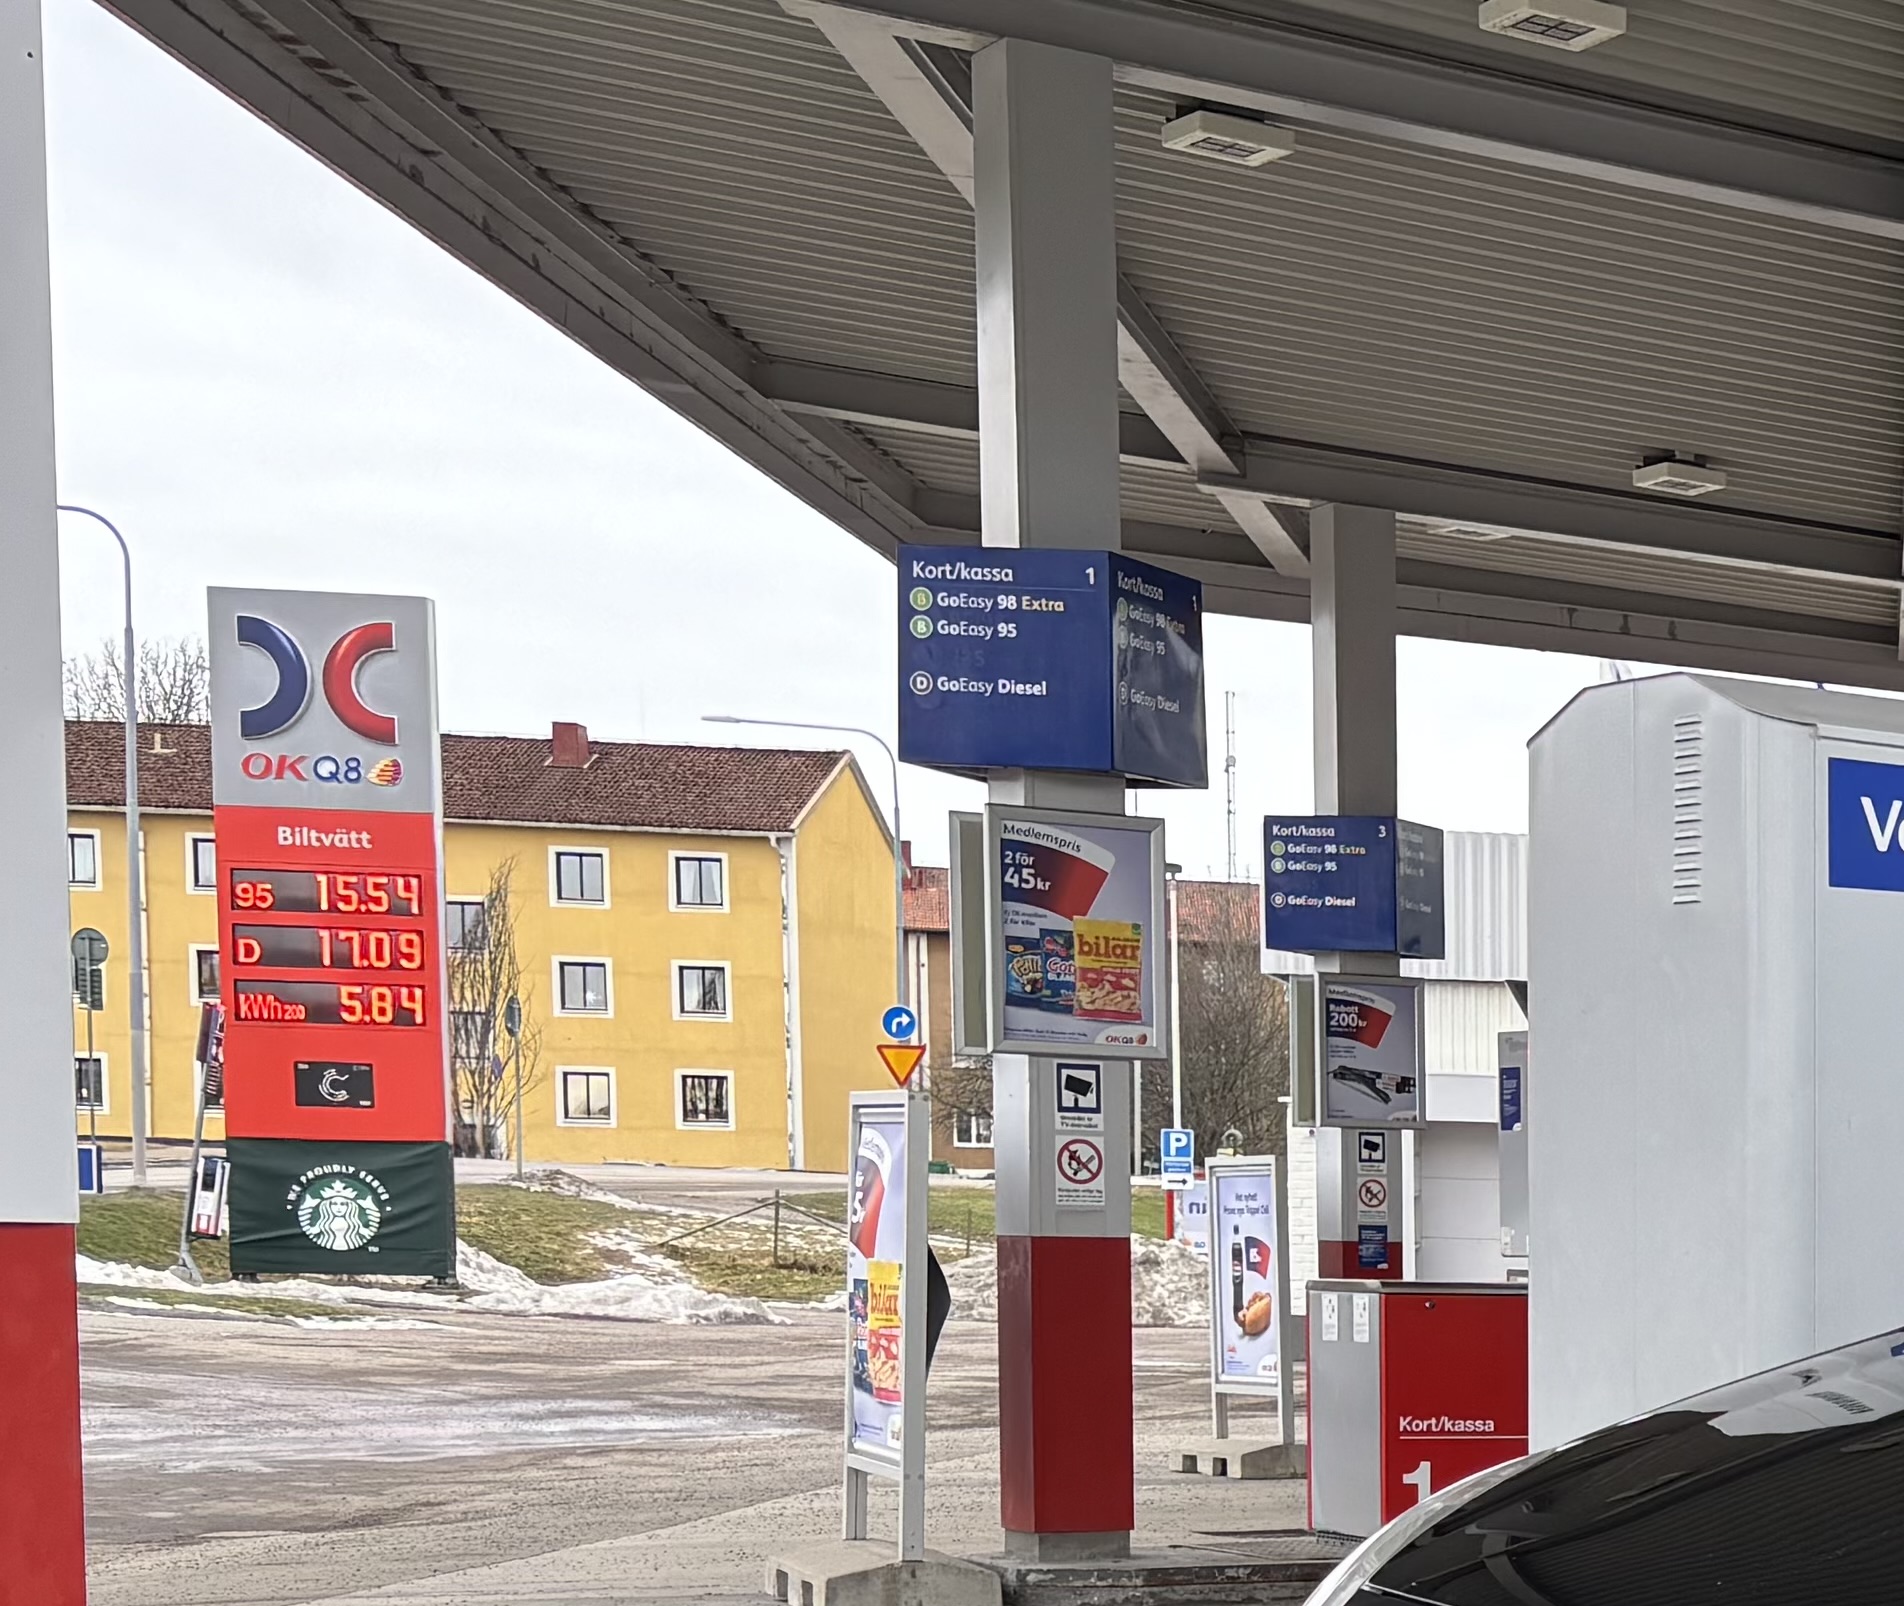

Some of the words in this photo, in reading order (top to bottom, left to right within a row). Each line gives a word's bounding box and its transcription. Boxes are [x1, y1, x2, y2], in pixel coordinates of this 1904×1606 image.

[912, 560, 1014, 583] Kort/kassa
[1085, 567, 1095, 585] 1
[937, 592, 994, 612] GoEasy
[997, 595, 1017, 611] 98
[1021, 596, 1065, 612] Extra
[937, 620, 994, 640] GoEasy
[997, 623, 1018, 638] 95
[937, 673, 994, 696] GoEasy
[998, 678, 1047, 696] Diesel
[277, 825, 373, 849] Biltvätt
[1003, 823, 1082, 853] Medlemspris
[1272, 825, 1335, 837] Kort/kassa
[1378, 826, 1387, 838] 3
[1004, 851, 1013, 864] 2
[1015, 851, 1036, 866] för
[1287, 861, 1323, 873] GoEasy
[1324, 861, 1338, 871] 95
[235, 882, 274, 909] 95
[315, 873, 420, 915] 15.54
[1287, 895, 1324, 908] GoEasy
[1324, 896, 1356, 907] Diesel
[237, 938, 262, 964] D
[318, 929, 422, 970] 17.09
[1078, 933, 1141, 960] bilar
[340, 985, 424, 1025] 5.84
[1169, 1132, 1188, 1157] P
[1399, 1416, 1495, 1432] Kort/kassa
[1402, 1461, 1431, 1504] 1
